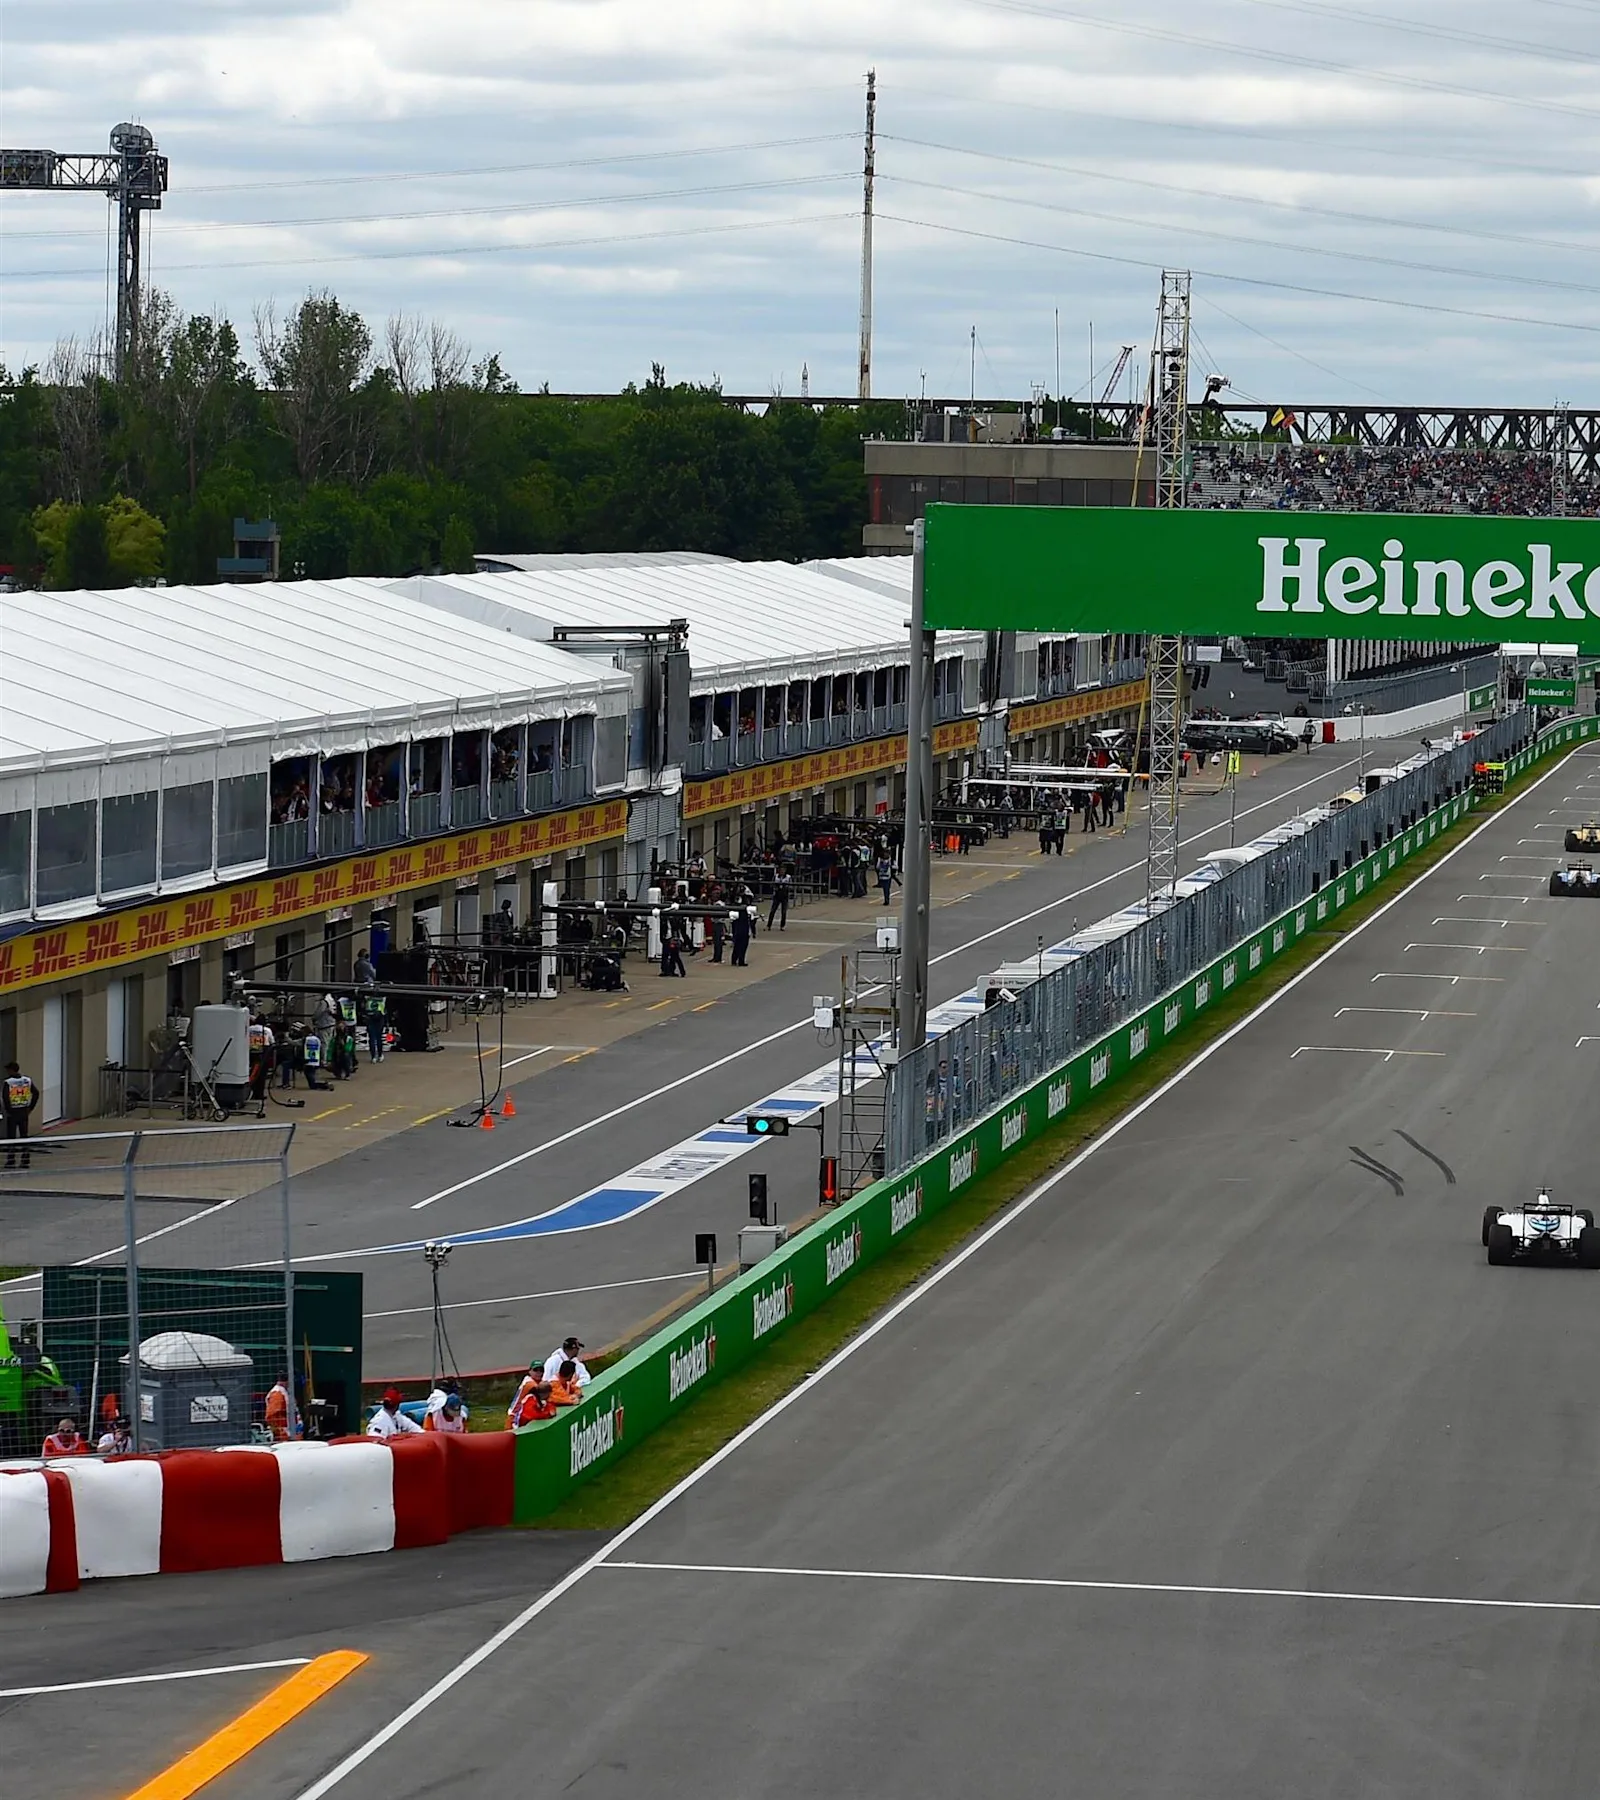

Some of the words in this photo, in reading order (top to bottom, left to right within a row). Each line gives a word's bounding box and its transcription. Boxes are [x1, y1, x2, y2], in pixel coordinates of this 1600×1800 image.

[32, 932, 68, 977] DHL
[86, 920, 120, 963] DHL
[137, 909, 170, 953] DHL
[183, 899, 216, 938] DHL
[229, 888, 260, 927] DHL
[273, 877, 301, 916] DHL
[313, 869, 338, 905] DHL
[351, 860, 376, 896] DHL
[388, 852, 412, 889] DHL
[424, 844, 446, 879] DHL
[457, 836, 478, 871] DHL
[489, 829, 510, 862] DHL
[521, 823, 539, 853] DHL
[549, 816, 567, 846] DHL
[578, 810, 596, 840] DHL
[603, 803, 623, 834] DHL
[753, 1272, 788, 1340] Heineken
[669, 1324, 712, 1402] Heineken
[569, 1395, 614, 1477] Heineken
